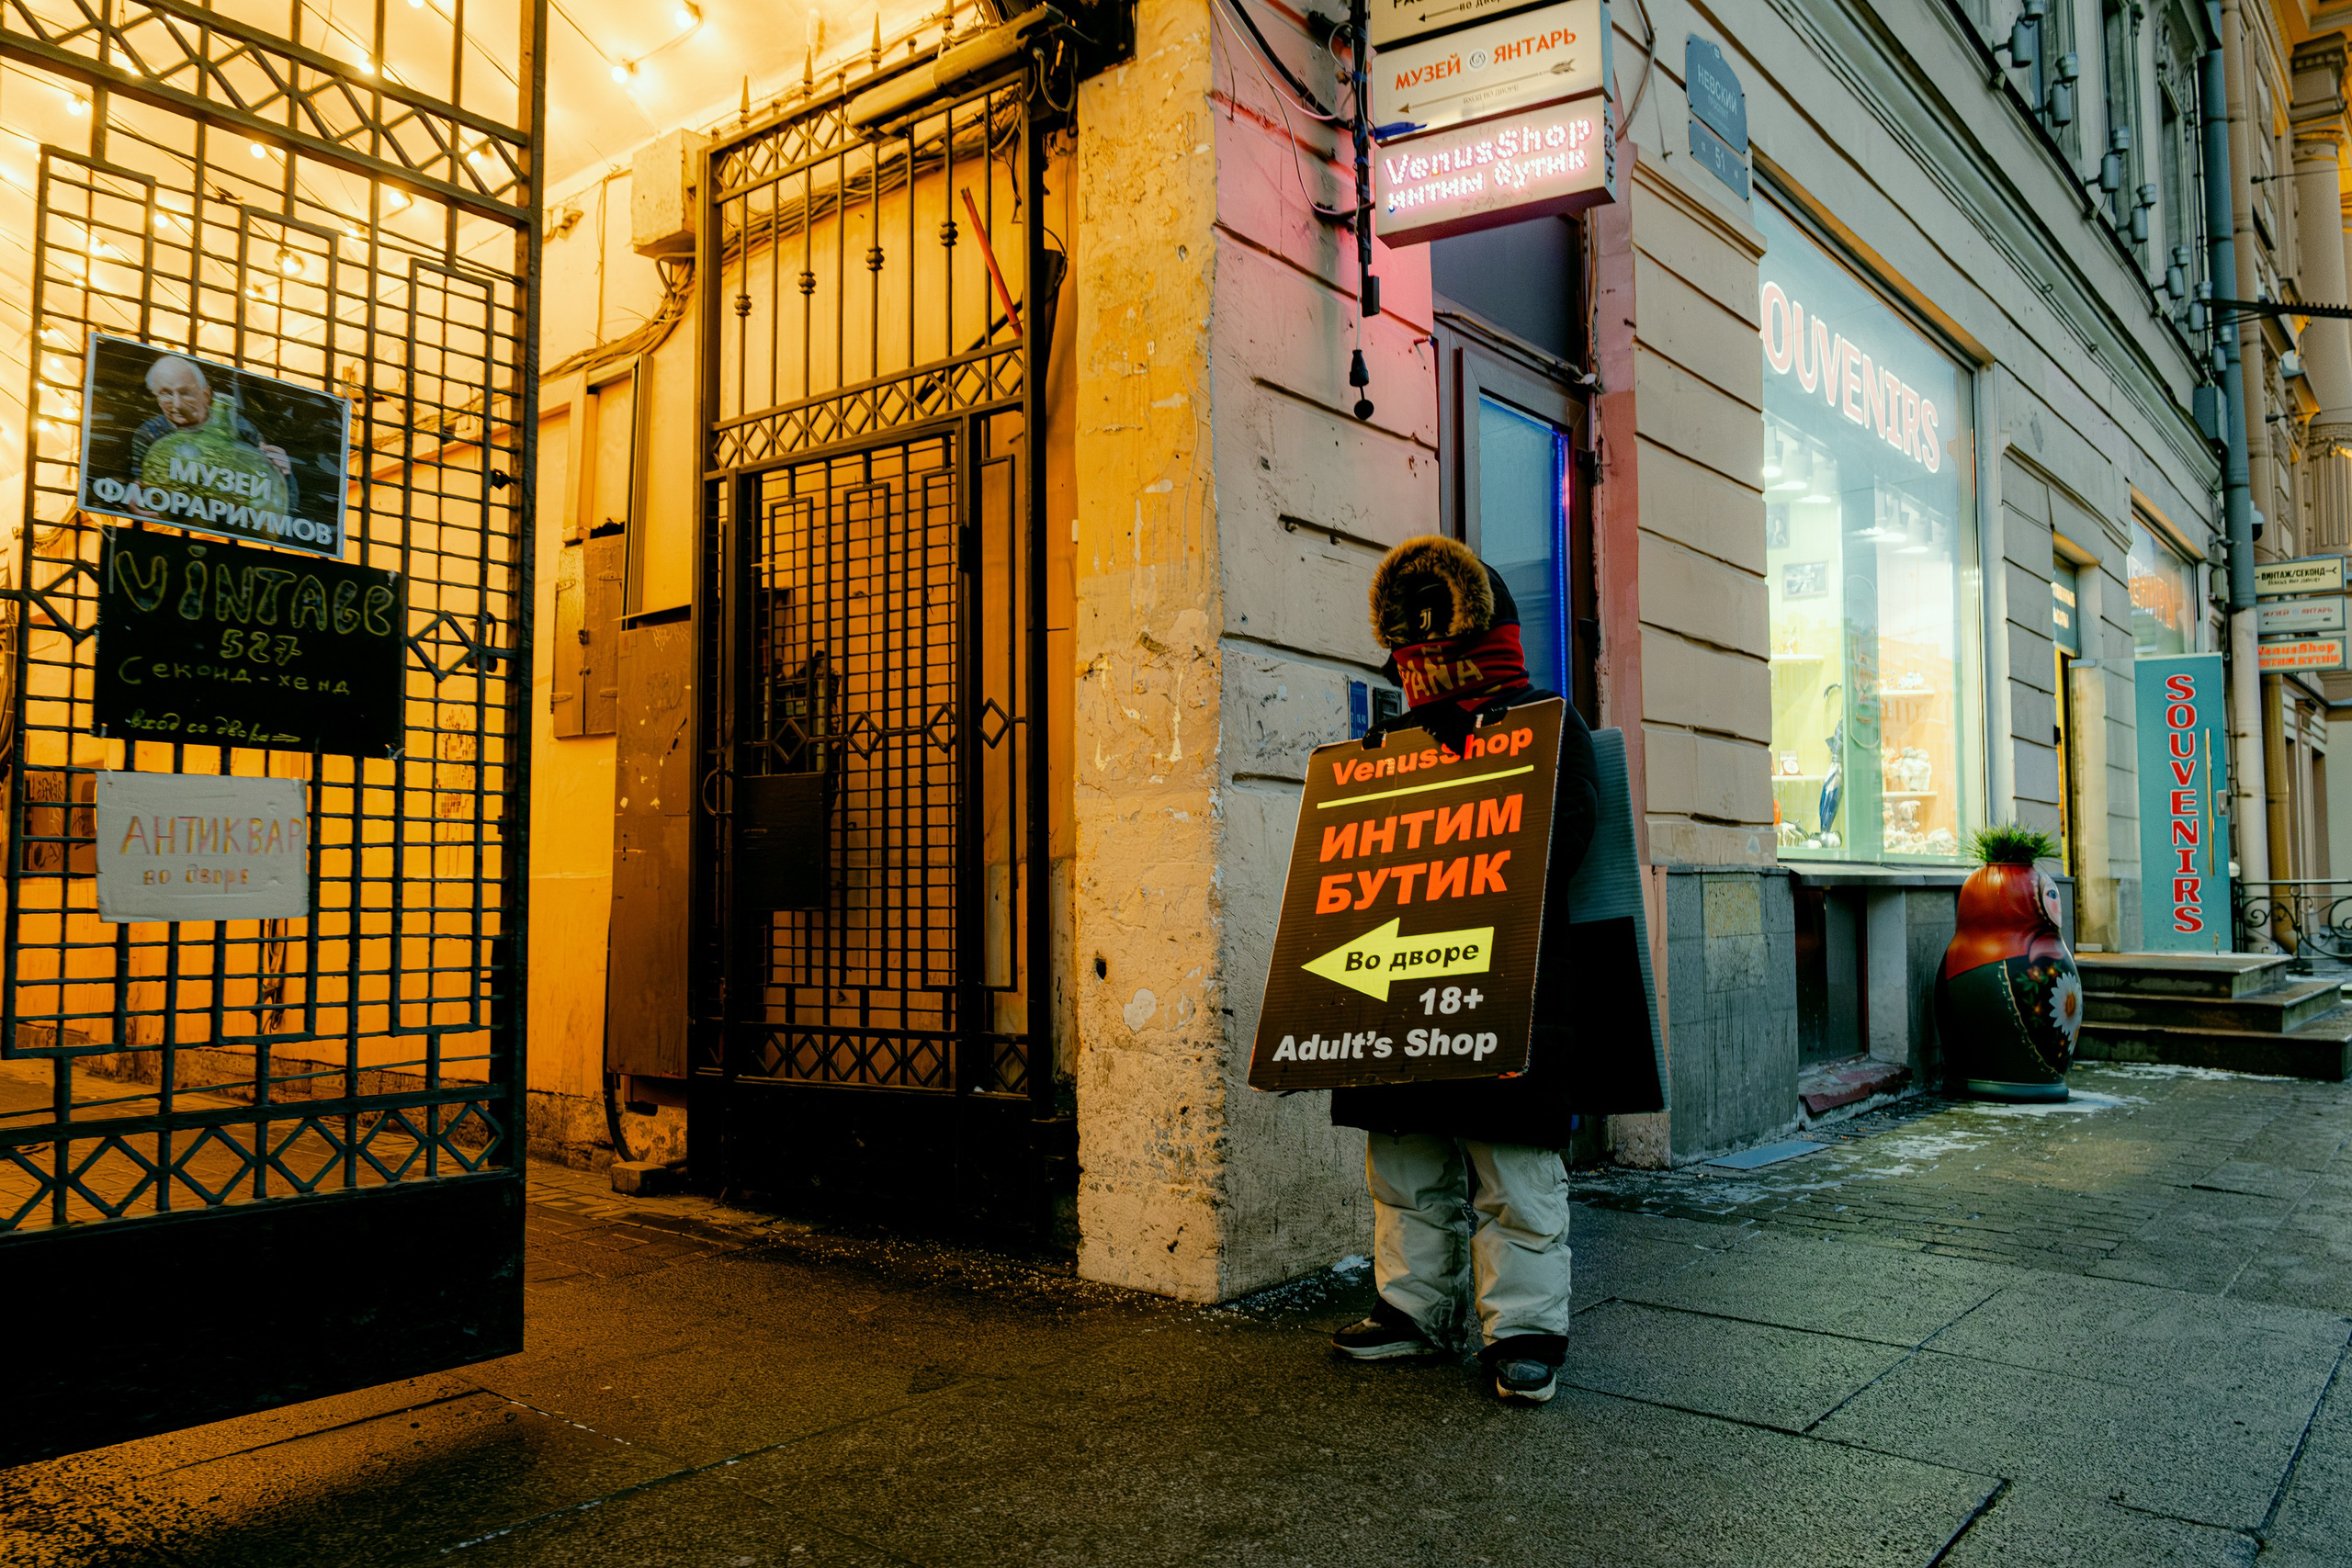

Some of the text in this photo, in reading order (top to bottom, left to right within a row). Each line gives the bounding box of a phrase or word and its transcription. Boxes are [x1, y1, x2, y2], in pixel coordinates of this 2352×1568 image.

[1395, 28, 1577, 90] МУЗЕЙ ЯНТАРЬ
[1697, 63, 1737, 116] НЕВСКИЙ
[1384, 119, 1592, 186] VenusShop
[1714, 145, 1725, 173] 51
[1759, 280, 1940, 474] OUVENIRS
[168, 457, 273, 502] МУЗЕЙ
[92, 476, 334, 547] ФЛОРАРИУМОВ
[220, 628, 302, 667] 527
[1319, 793, 1524, 863] ИНТИМ
[2164, 673, 2205, 934] SOUVENIRS
[120, 815, 303, 856] АНТИКВАР
[1315, 850, 1511, 916] БУТИК
[1344, 943, 1479, 973] Во дворе
[1419, 986, 1485, 1016] 18+
[1404, 1027, 1498, 1062] Shop
